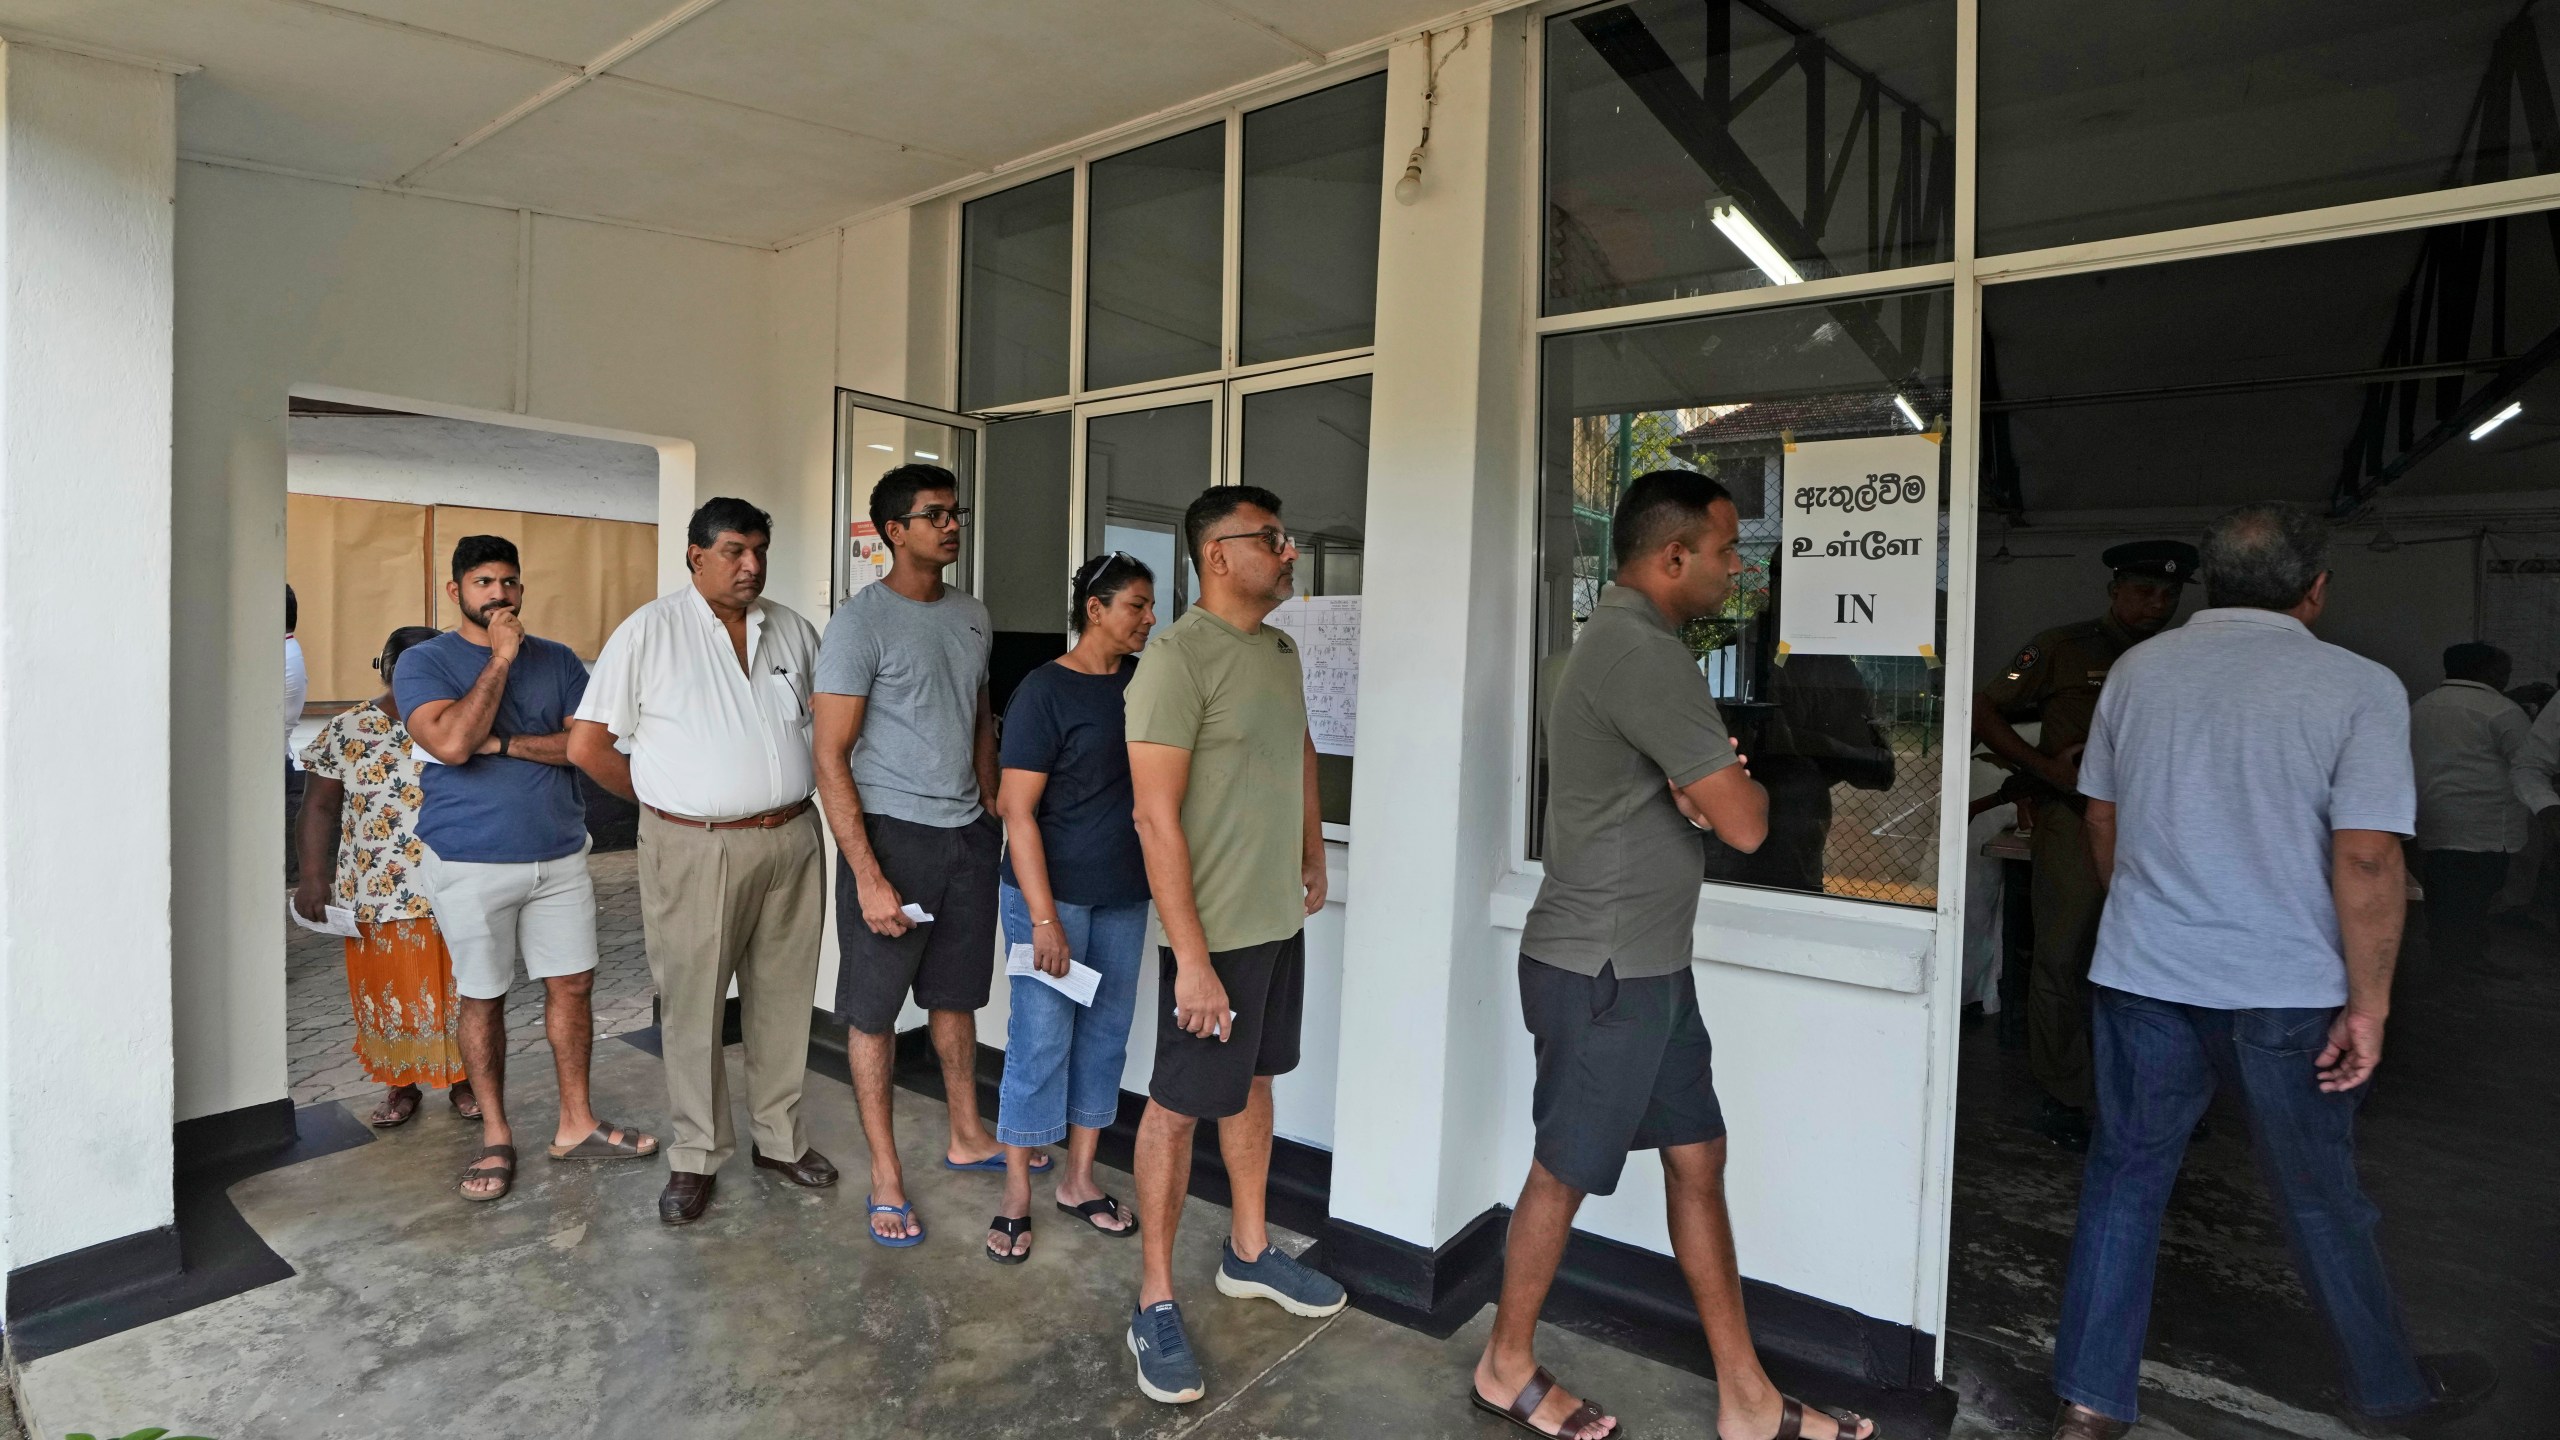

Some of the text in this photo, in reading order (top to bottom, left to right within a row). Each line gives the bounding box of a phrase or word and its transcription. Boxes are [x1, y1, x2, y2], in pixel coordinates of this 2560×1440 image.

[1794, 473, 1926, 514] ඇතුල්වීම
[1792, 530, 1924, 560] உள்ளே
[1834, 594, 1877, 623] IN
